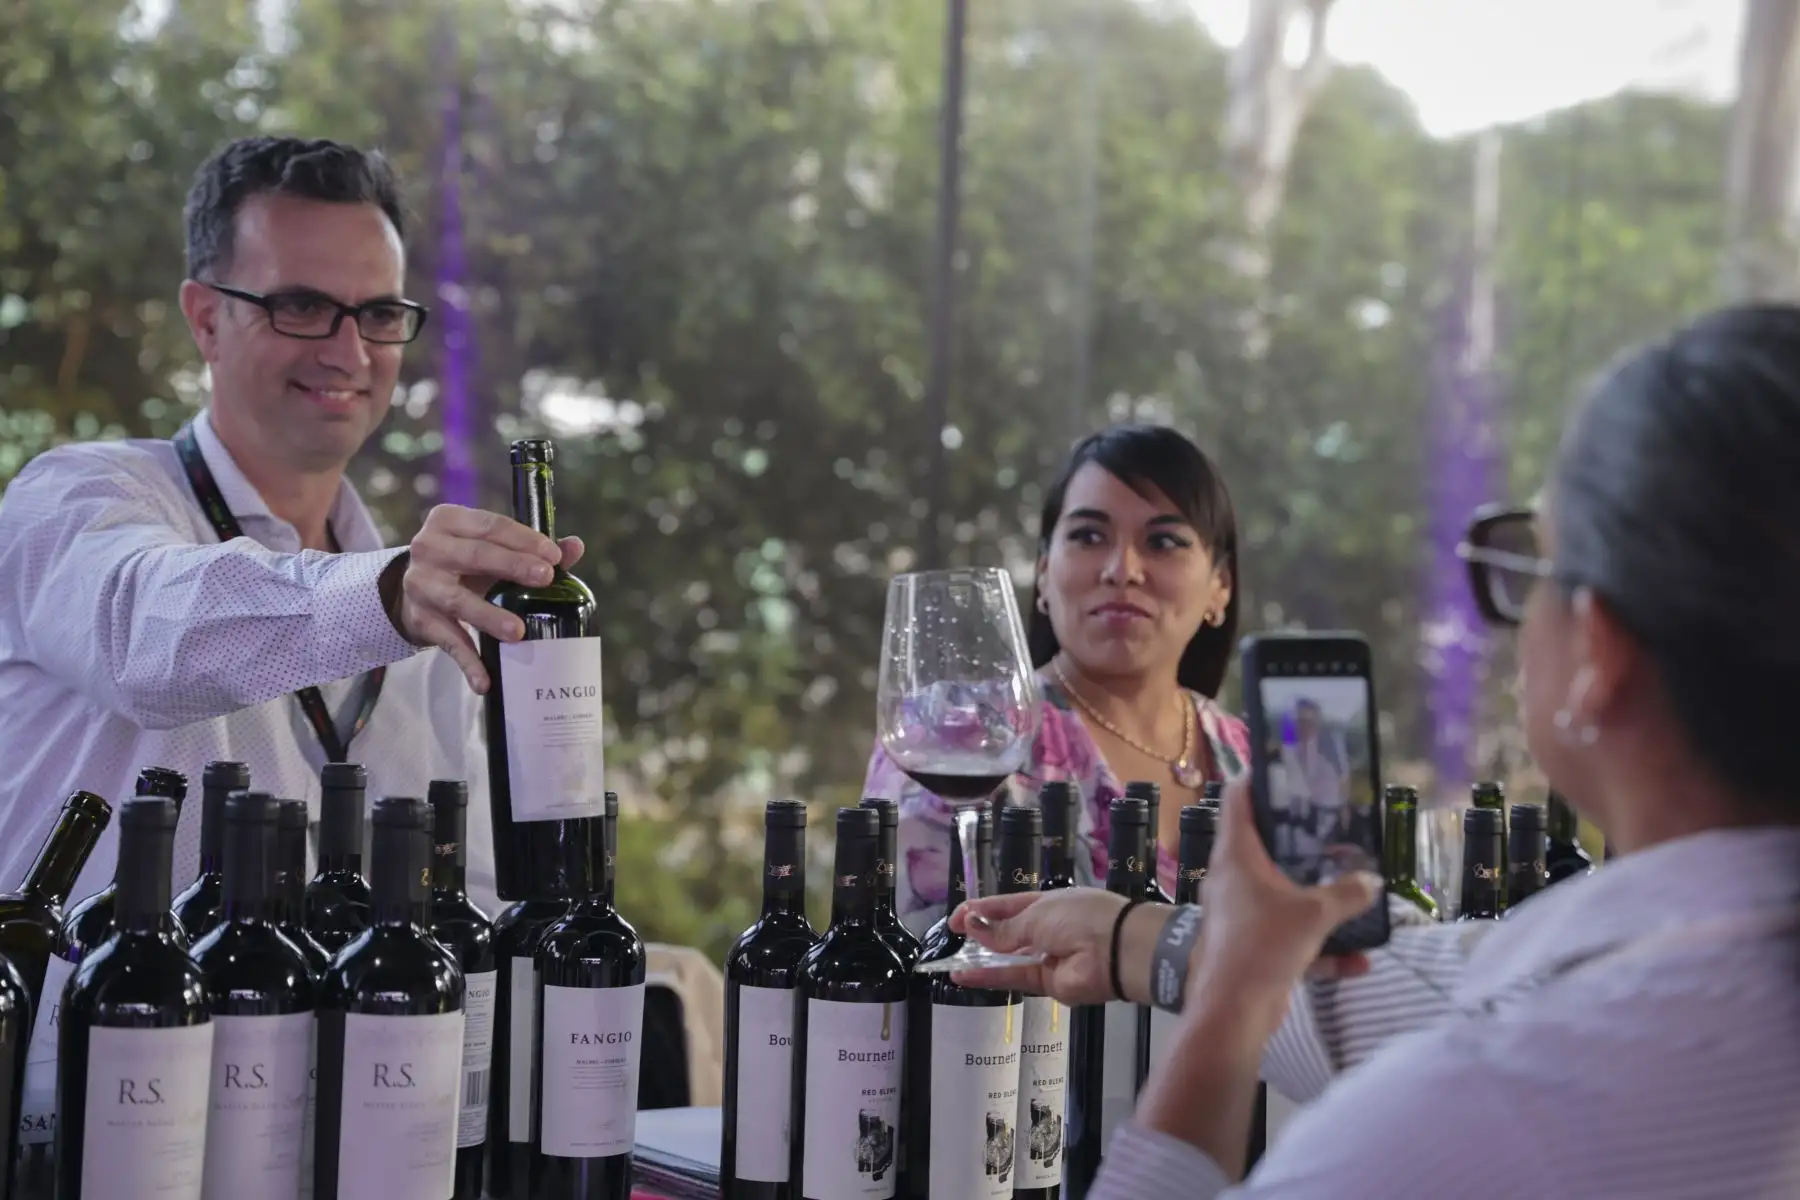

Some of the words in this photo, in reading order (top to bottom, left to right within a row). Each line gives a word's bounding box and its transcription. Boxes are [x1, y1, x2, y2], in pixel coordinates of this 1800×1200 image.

[535, 685, 596, 700] FANGIO
[570, 1031, 632, 1045] FANGIO
[1020, 1041, 1063, 1054] ournett
[838, 1049, 896, 1062] Bournett
[964, 1052, 1017, 1066] Bournett
[224, 1063, 269, 1088] R.S.
[373, 1062, 416, 1088] R.S.
[119, 1078, 165, 1105] R.S.
[861, 1088, 877, 1096] RED
[988, 1091, 1002, 1099] RED
